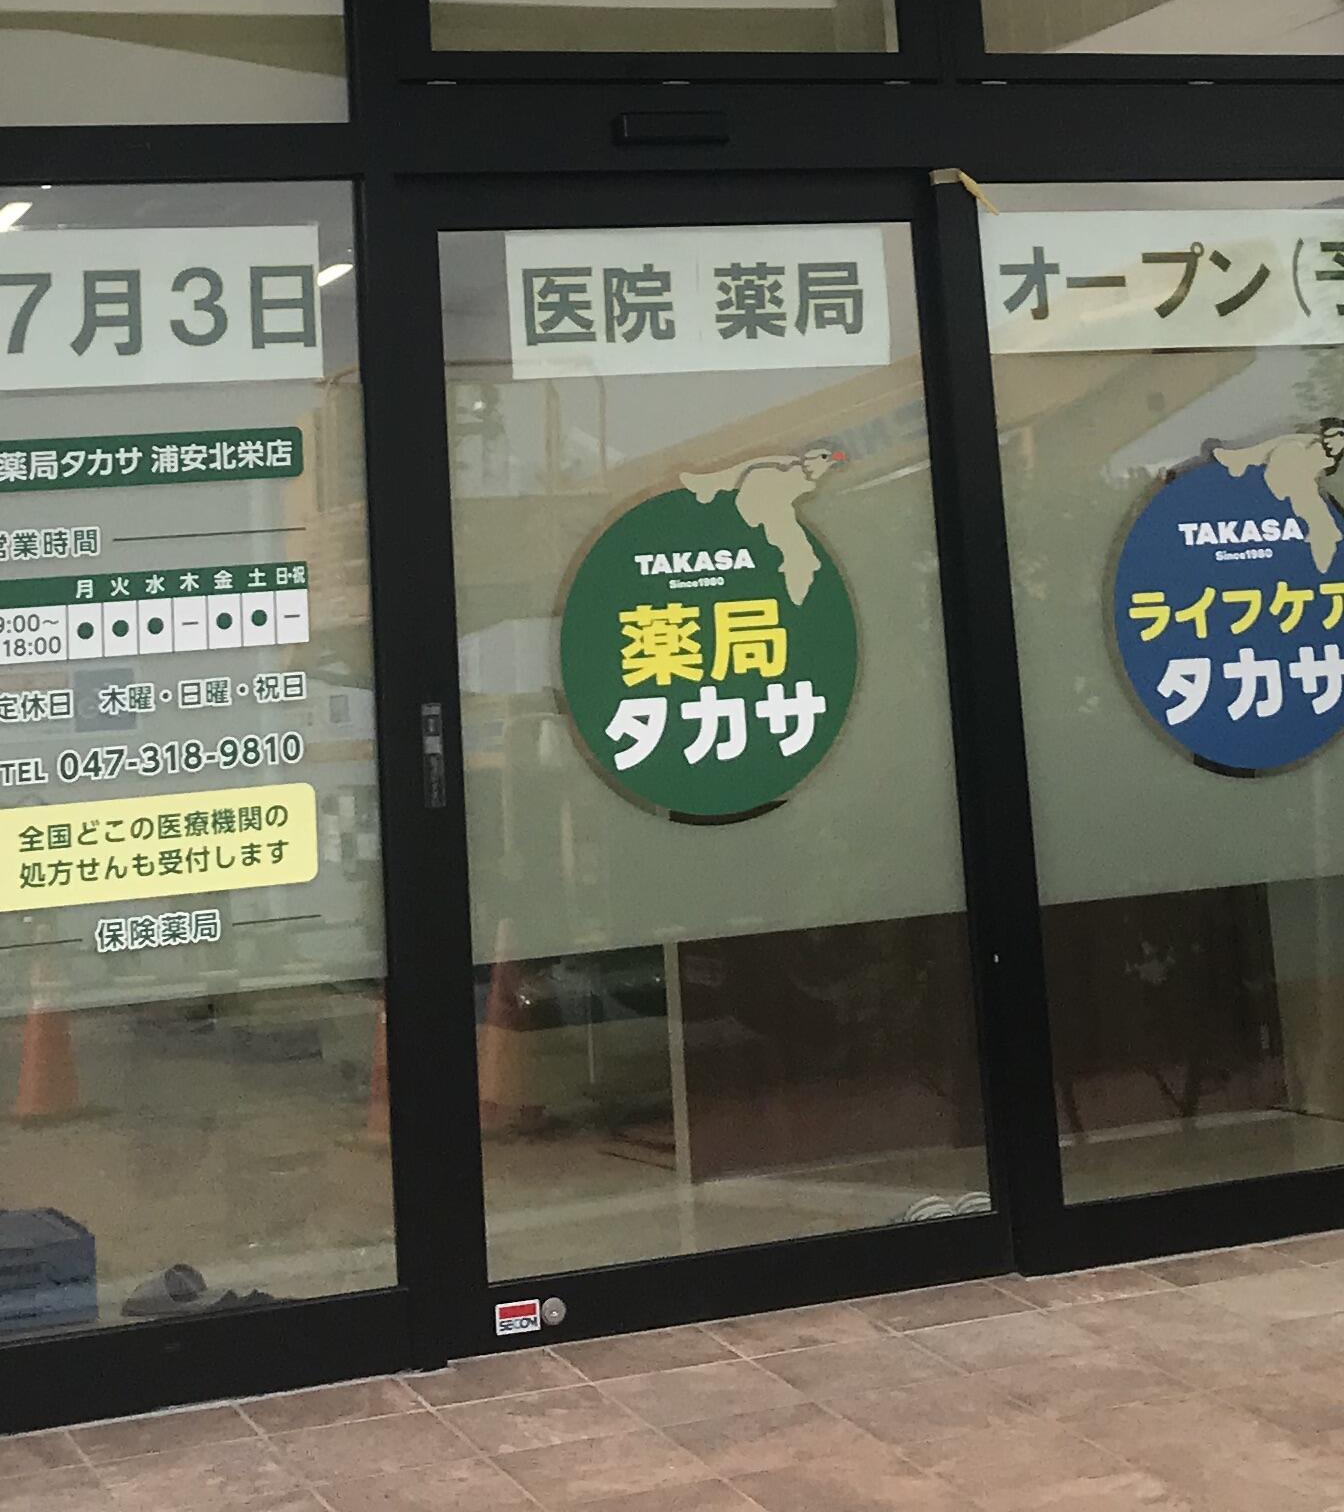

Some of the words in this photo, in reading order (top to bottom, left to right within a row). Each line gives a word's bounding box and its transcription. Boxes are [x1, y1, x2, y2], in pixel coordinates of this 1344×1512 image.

[521, 264, 676, 346] 医院
[713, 262, 865, 340] 薬局
[151, 439, 293, 474] 浦安北栄店
[1178, 518, 1304, 546] TAKASA
[75, 579, 94, 599] 月
[110, 576, 130, 597] 火
[145, 574, 165, 593] 水
[179, 572, 200, 591] 木
[213, 569, 233, 589] 金
[247, 567, 267, 587] 土
[634, 548, 755, 576] TAKASA
[2, 637, 61, 657] 18:00
[619, 598, 788, 687] 薬局
[605, 680, 827, 771] タカサ
[58, 731, 305, 782] 047-318-9810
[18, 803, 289, 853] 全国どこの医療機関の
[19, 839, 290, 889] 処方せんも受付します
[95, 910, 221, 952] 保険薬局
